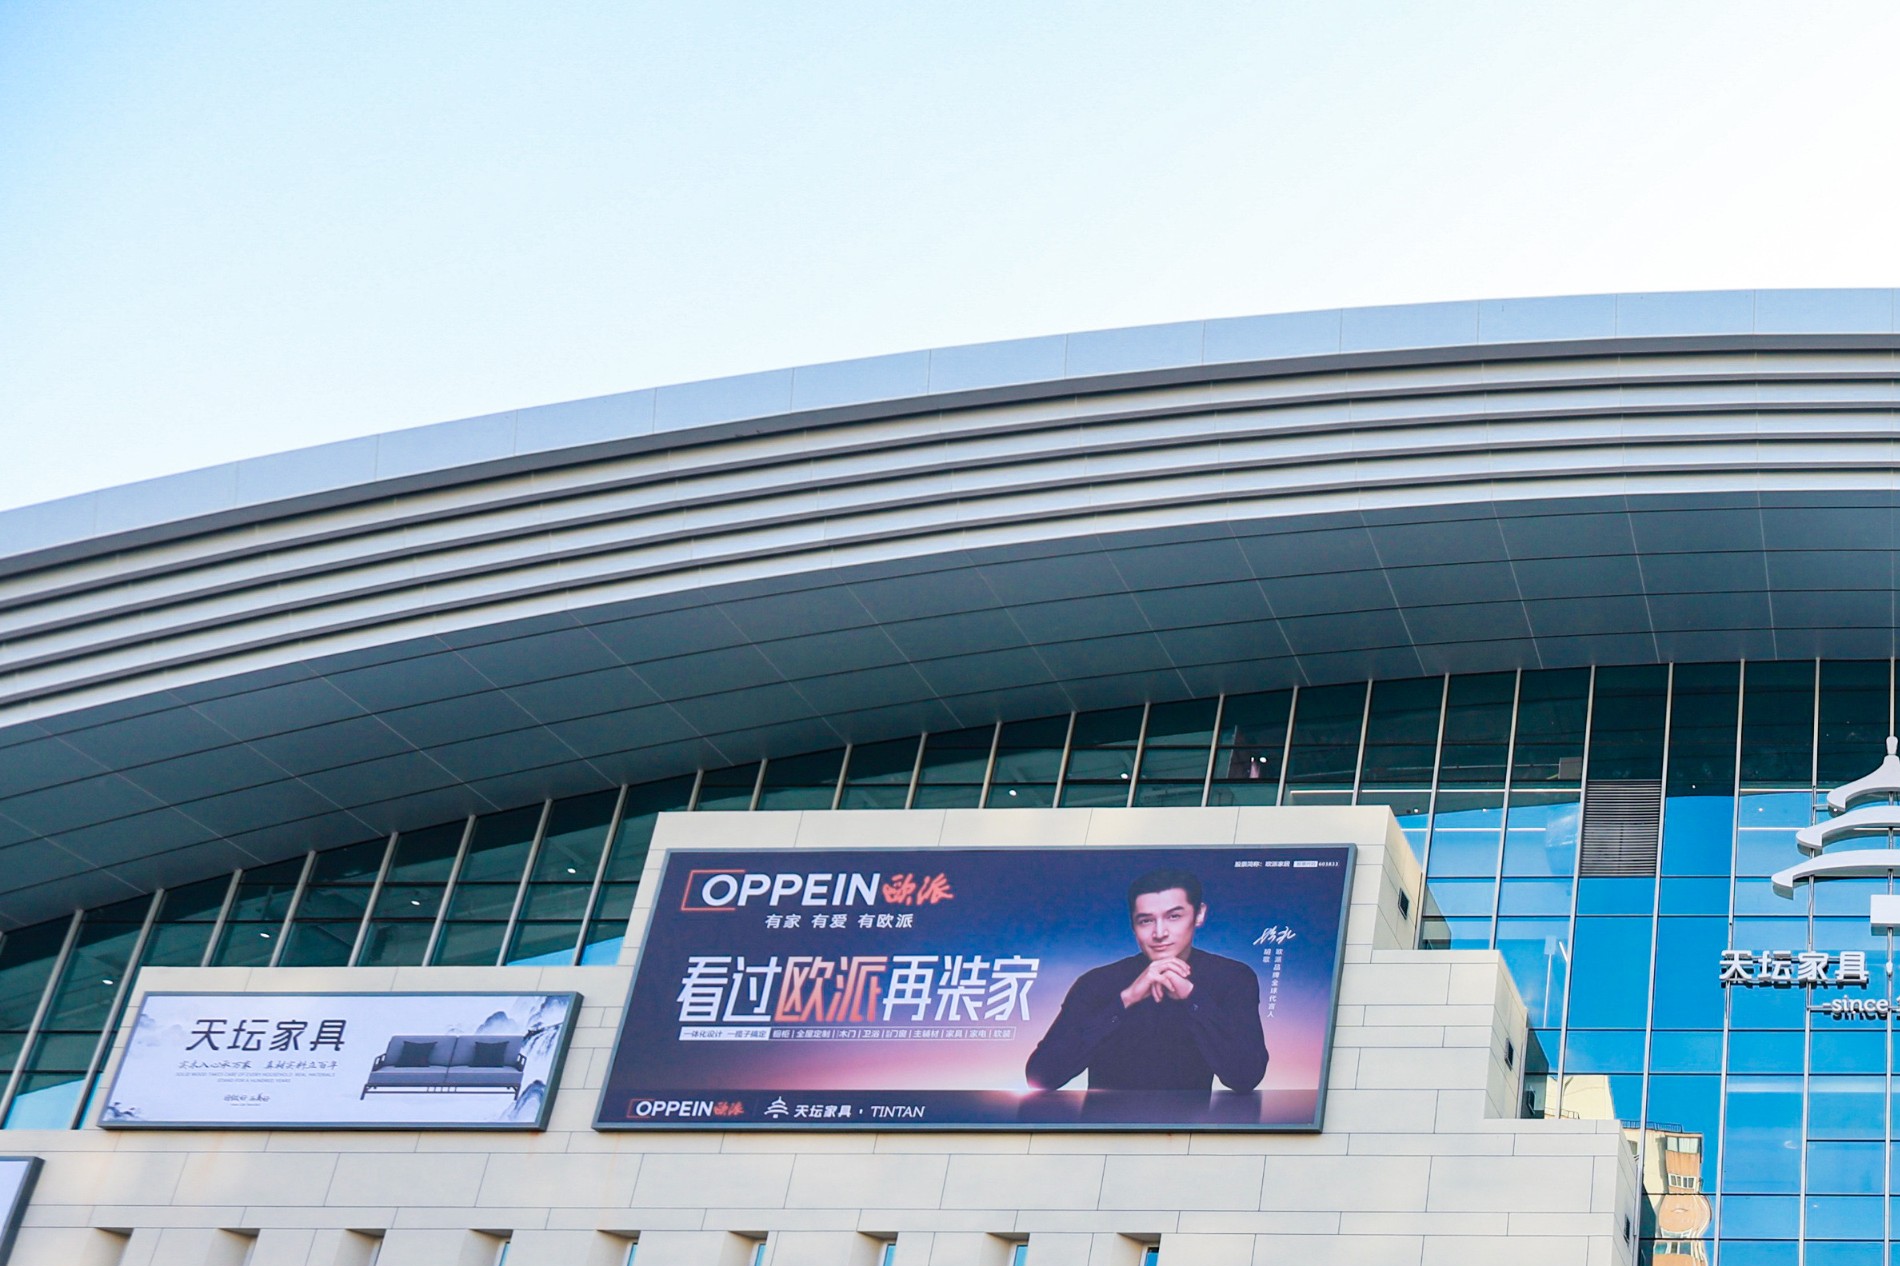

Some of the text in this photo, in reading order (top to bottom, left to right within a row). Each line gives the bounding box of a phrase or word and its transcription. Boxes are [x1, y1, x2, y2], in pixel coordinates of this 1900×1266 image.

[701, 873, 881, 907] OPPEIN
[764, 913, 914, 929] 有家 有爱 有欧派
[1719, 950, 1869, 984] 天坛家具
[677, 955, 1040, 1022] 看过欧派再装家
[185, 1019, 347, 1051] 天坛家具
[635, 1101, 714, 1117] OPPEIN
[794, 1104, 925, 1118] 天坛家具 TINTAN
